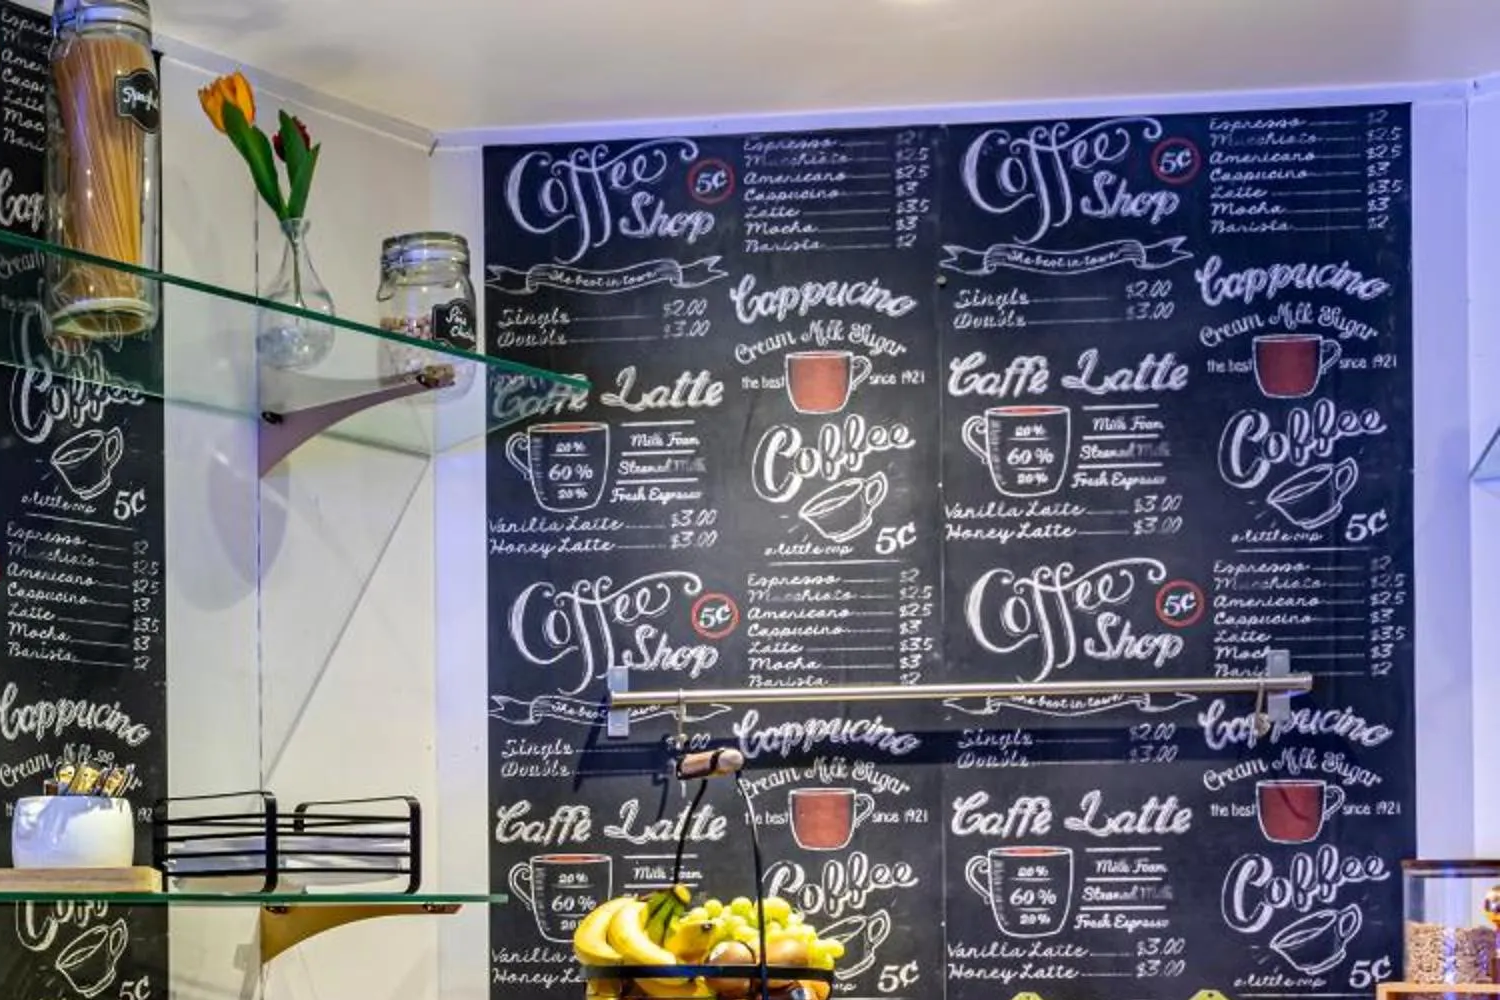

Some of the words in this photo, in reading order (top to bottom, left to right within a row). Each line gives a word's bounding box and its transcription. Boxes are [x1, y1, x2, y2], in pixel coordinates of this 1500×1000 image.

[504, 137, 699, 265] Coffee
[961, 117, 1162, 244] Coffee
[1081, 170, 1179, 224] Shop
[619, 192, 715, 244] Shop
[729, 272, 917, 323] Cappucino
[1194, 255, 1390, 306] Cappucino
[735, 329, 797, 364] Cream
[801, 319, 844, 346] Milk
[847, 323, 907, 358] Sugar
[601, 365, 725, 412] Latte
[1061, 348, 1189, 394] Latte
[753, 413, 916, 501] Coffee
[1218, 400, 1387, 489] Coffee
[488, 538, 557, 557] Honey
[557, 536, 616, 553] Latte
[876, 524, 917, 555] 5¢
[945, 524, 1018, 543] Honey
[1017, 522, 1077, 539] Latte
[1345, 509, 1389, 542] 5¢
[509, 571, 702, 696] Coffee
[622, 624, 719, 678] Shop
[1084, 612, 1184, 667] Shop
[1203, 757, 1269, 790] Cream
[1271, 747, 1318, 775] Milk
[1321, 751, 1383, 787] Sugar
[1064, 789, 1192, 836] Latte
[1221, 844, 1390, 934] Coffee
[947, 942, 1028, 958] Vanilla
[1029, 942, 1089, 957] Latte
[1348, 955, 1392, 989] 5¢
